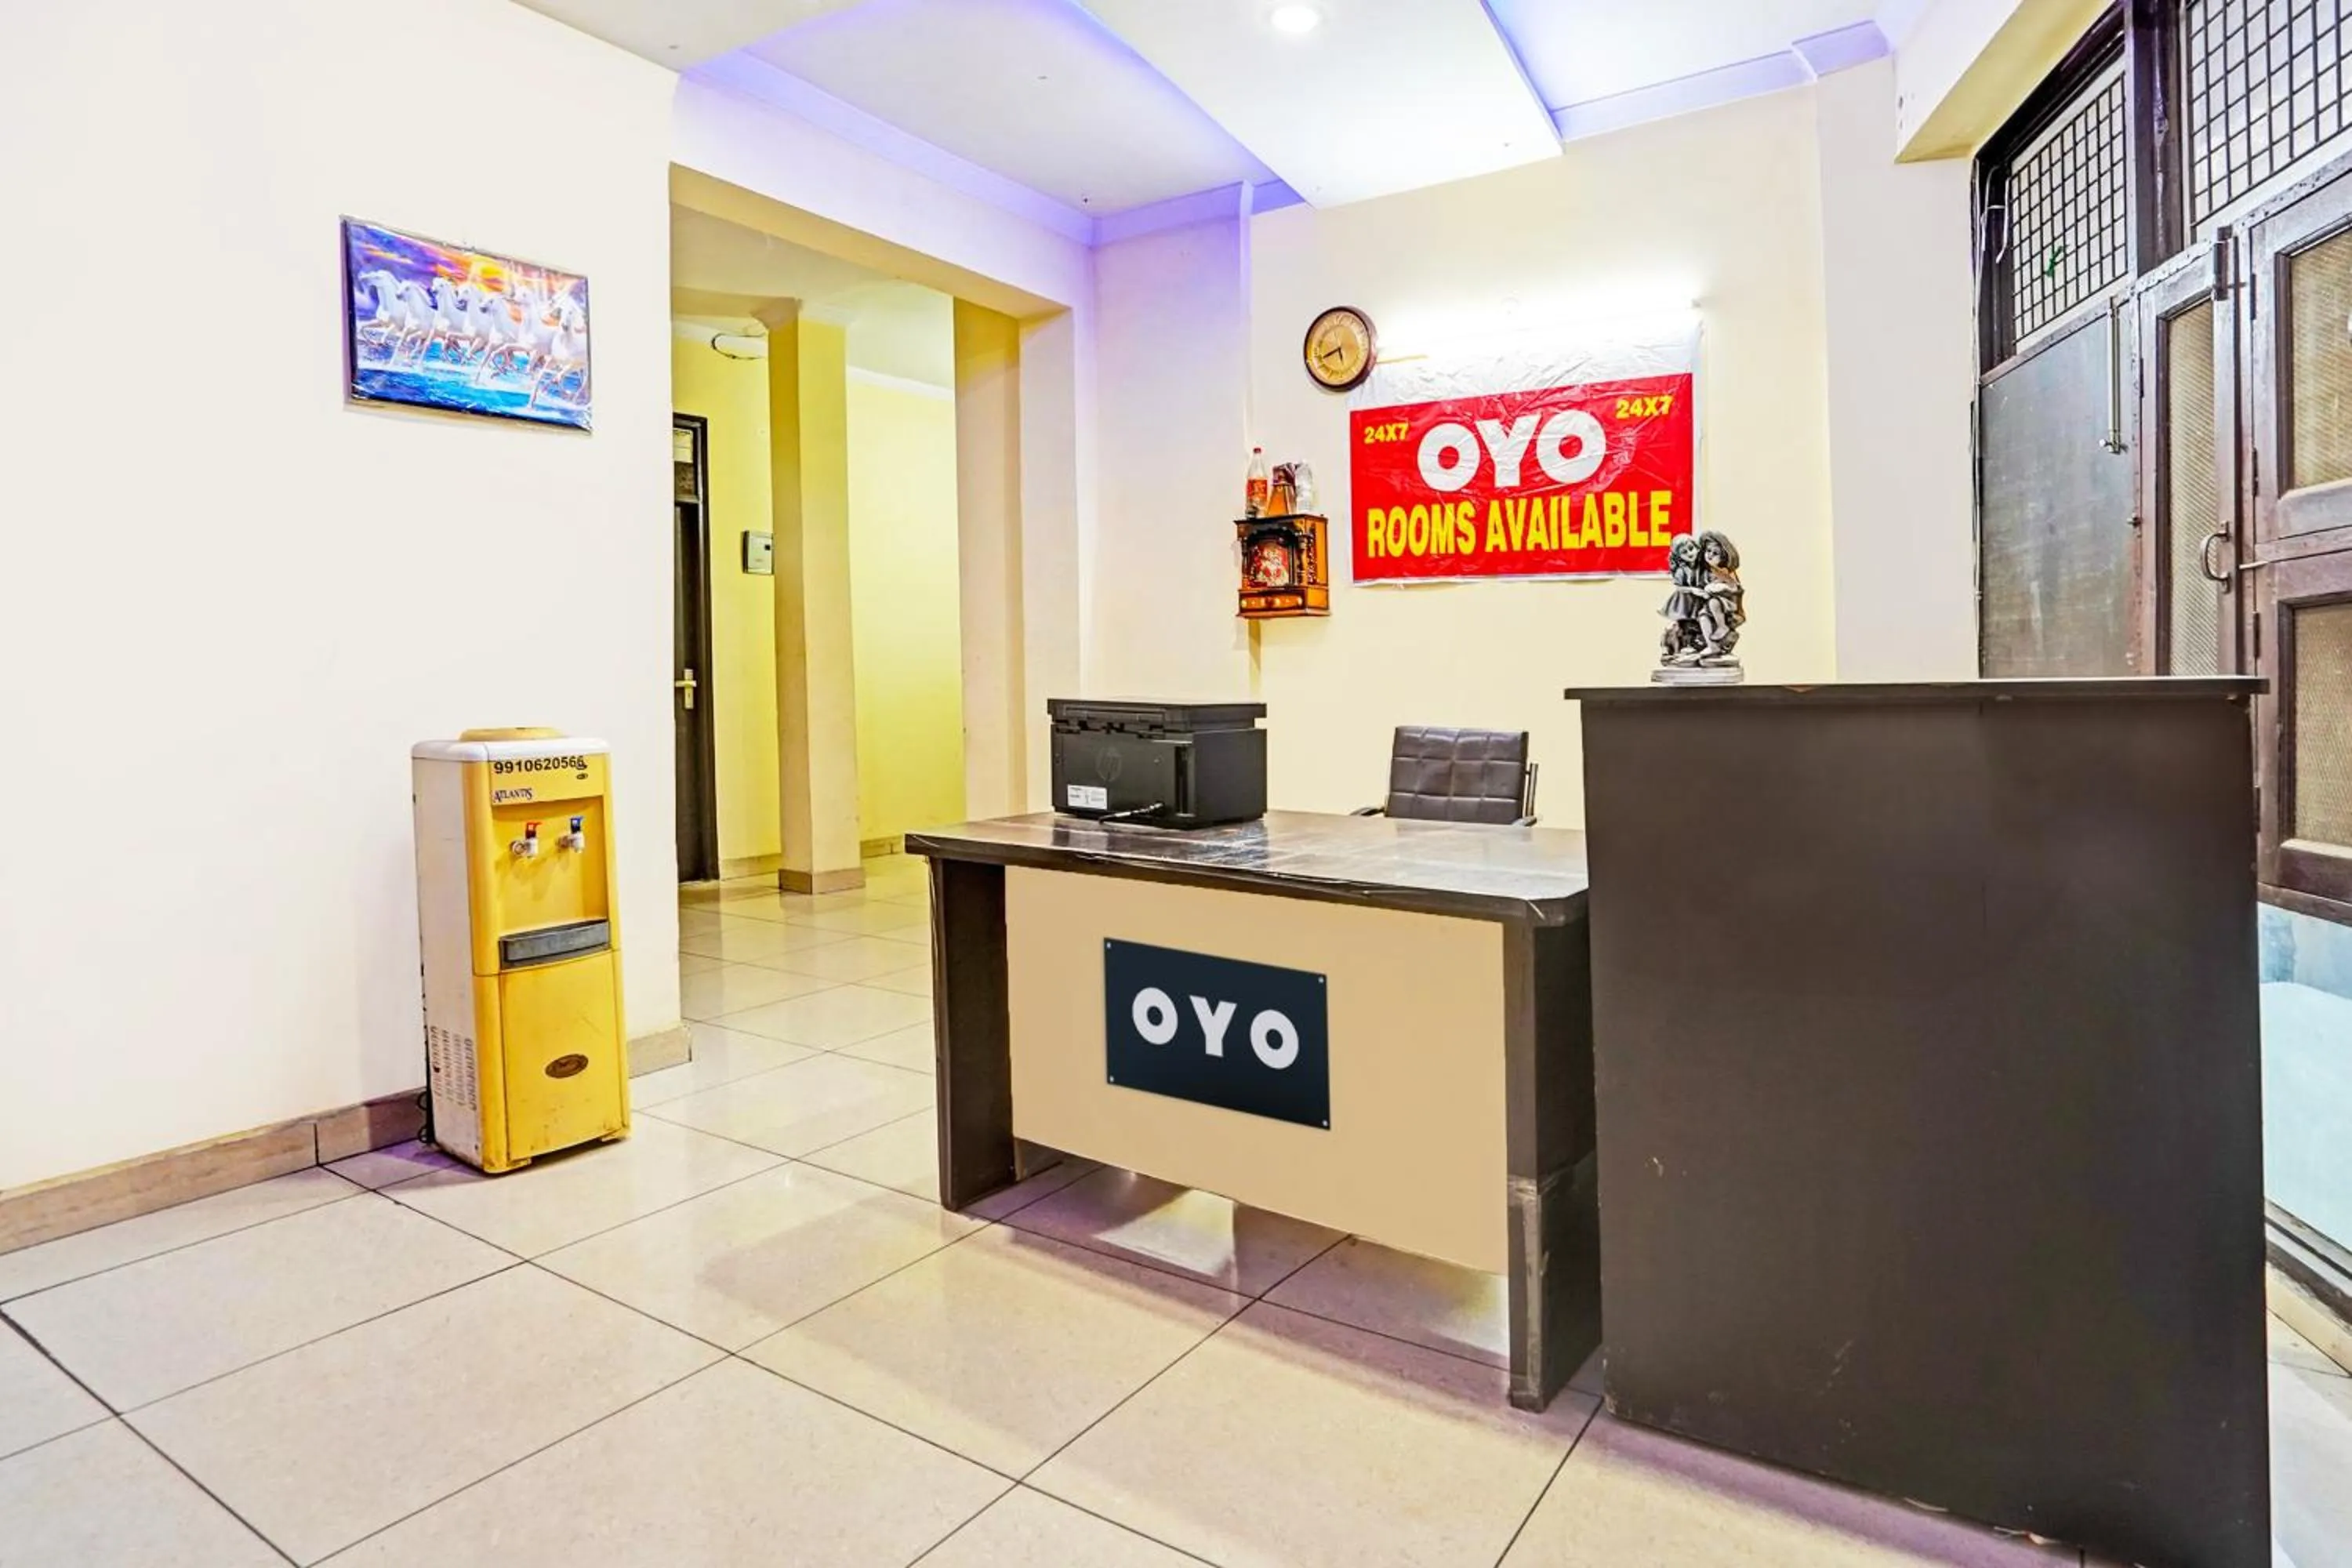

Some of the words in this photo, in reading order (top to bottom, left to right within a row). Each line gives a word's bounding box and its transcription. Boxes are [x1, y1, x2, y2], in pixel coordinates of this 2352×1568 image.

[1363, 422, 1409, 444] 24X7
[1615, 395, 1673, 419] 24X7
[1417, 408, 1606, 492] OYO
[1367, 500, 1476, 558] ROOMS
[1484, 490, 1672, 553] AVAILABLE
[1131, 986, 1300, 1070] OYO
